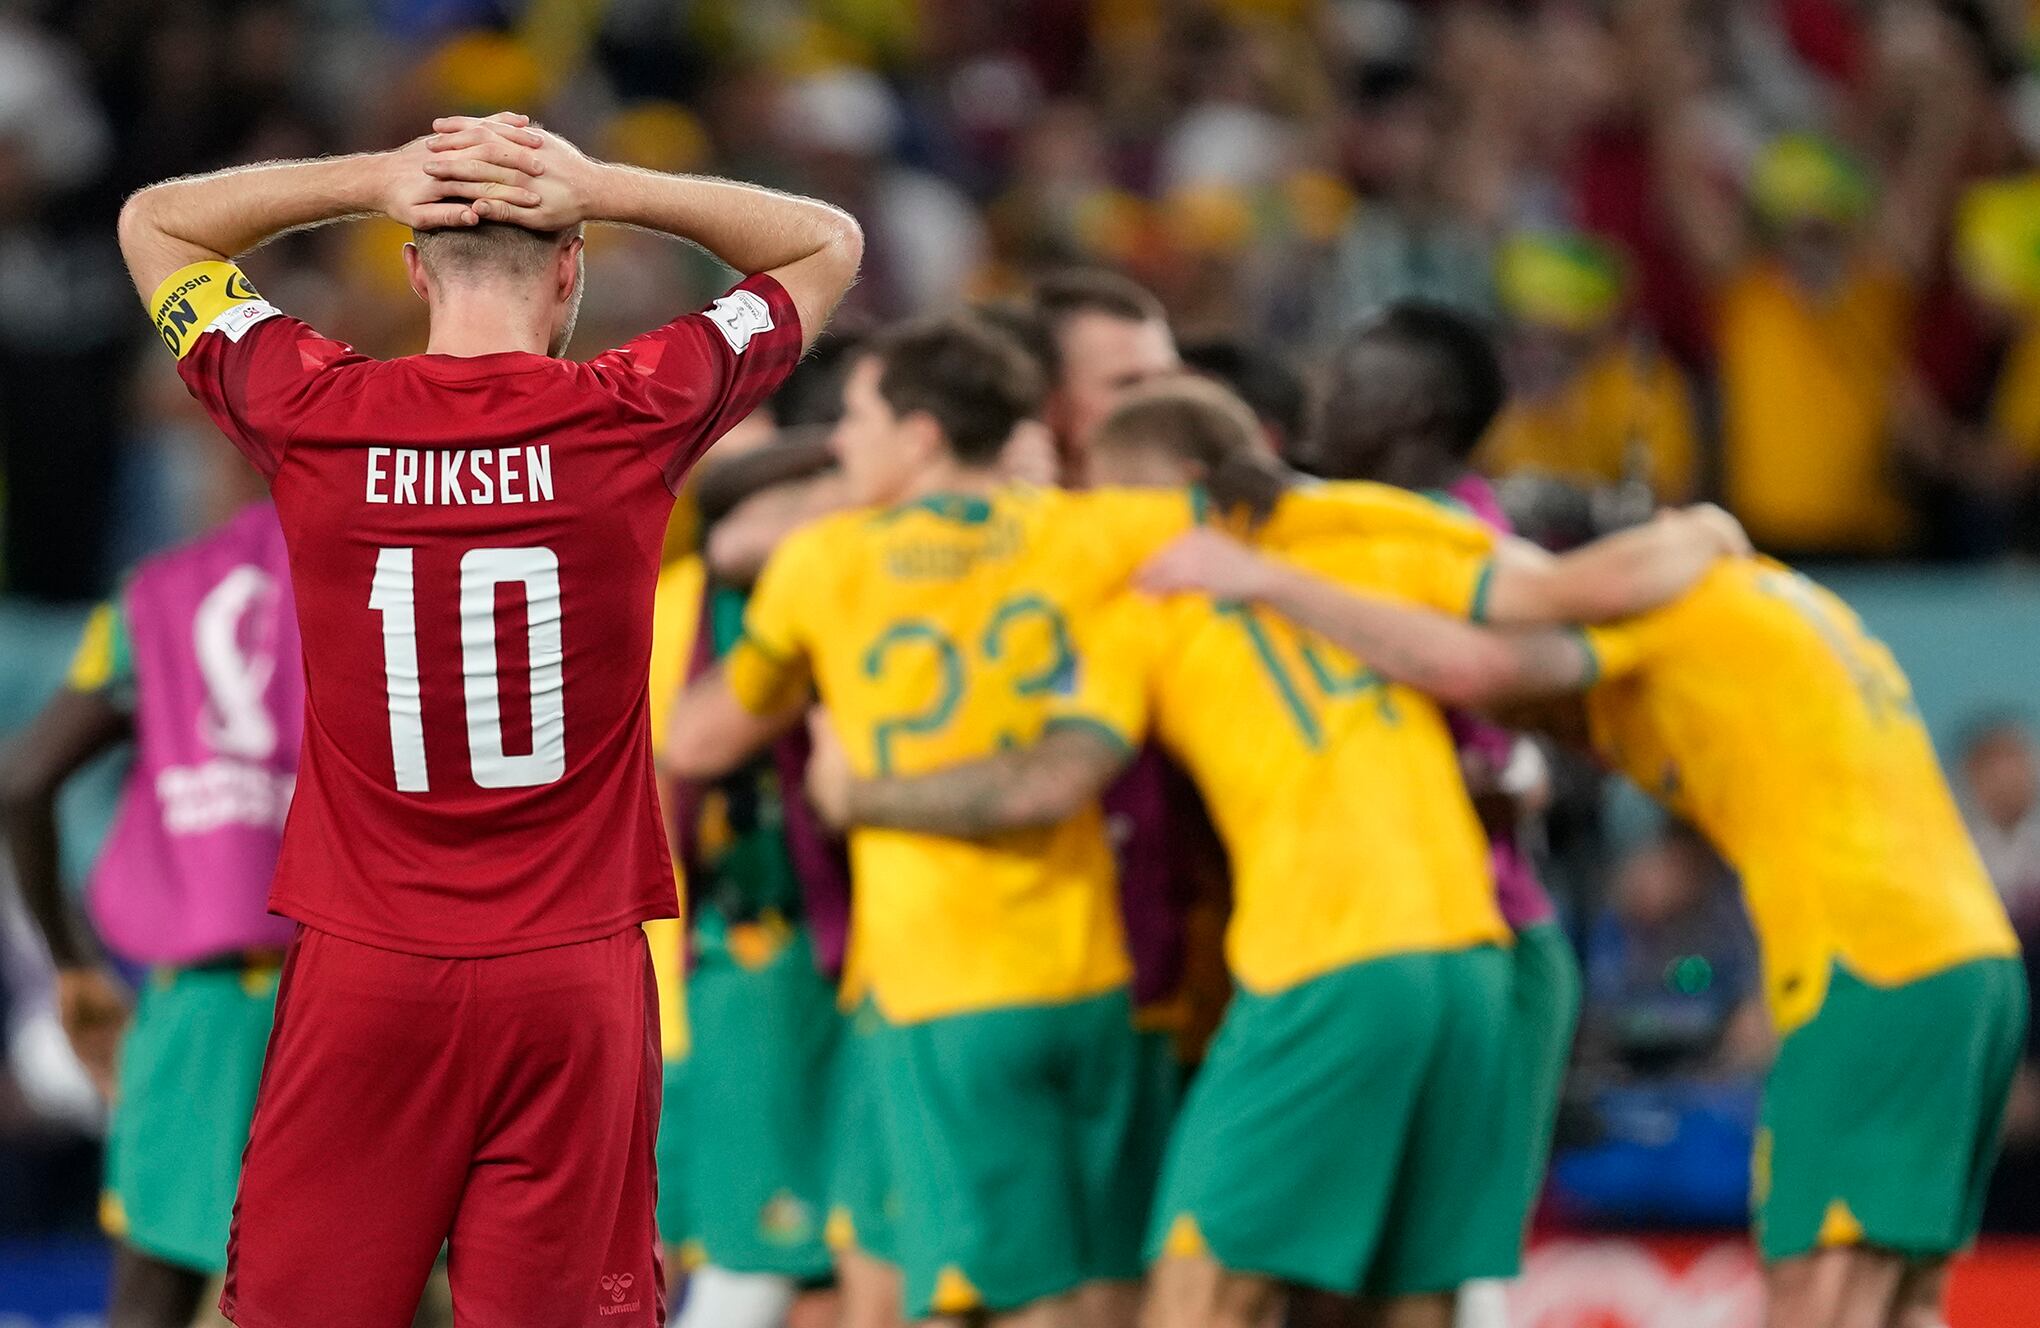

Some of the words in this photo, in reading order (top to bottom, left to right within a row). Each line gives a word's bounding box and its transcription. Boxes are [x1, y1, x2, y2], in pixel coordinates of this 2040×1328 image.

[156, 274, 212, 335] DISCRIMIN
[162, 298, 198, 357] NO
[366, 445, 554, 505] ERIKSEN
[368, 546, 566, 792] 10
[599, 1299, 641, 1317] hummel
